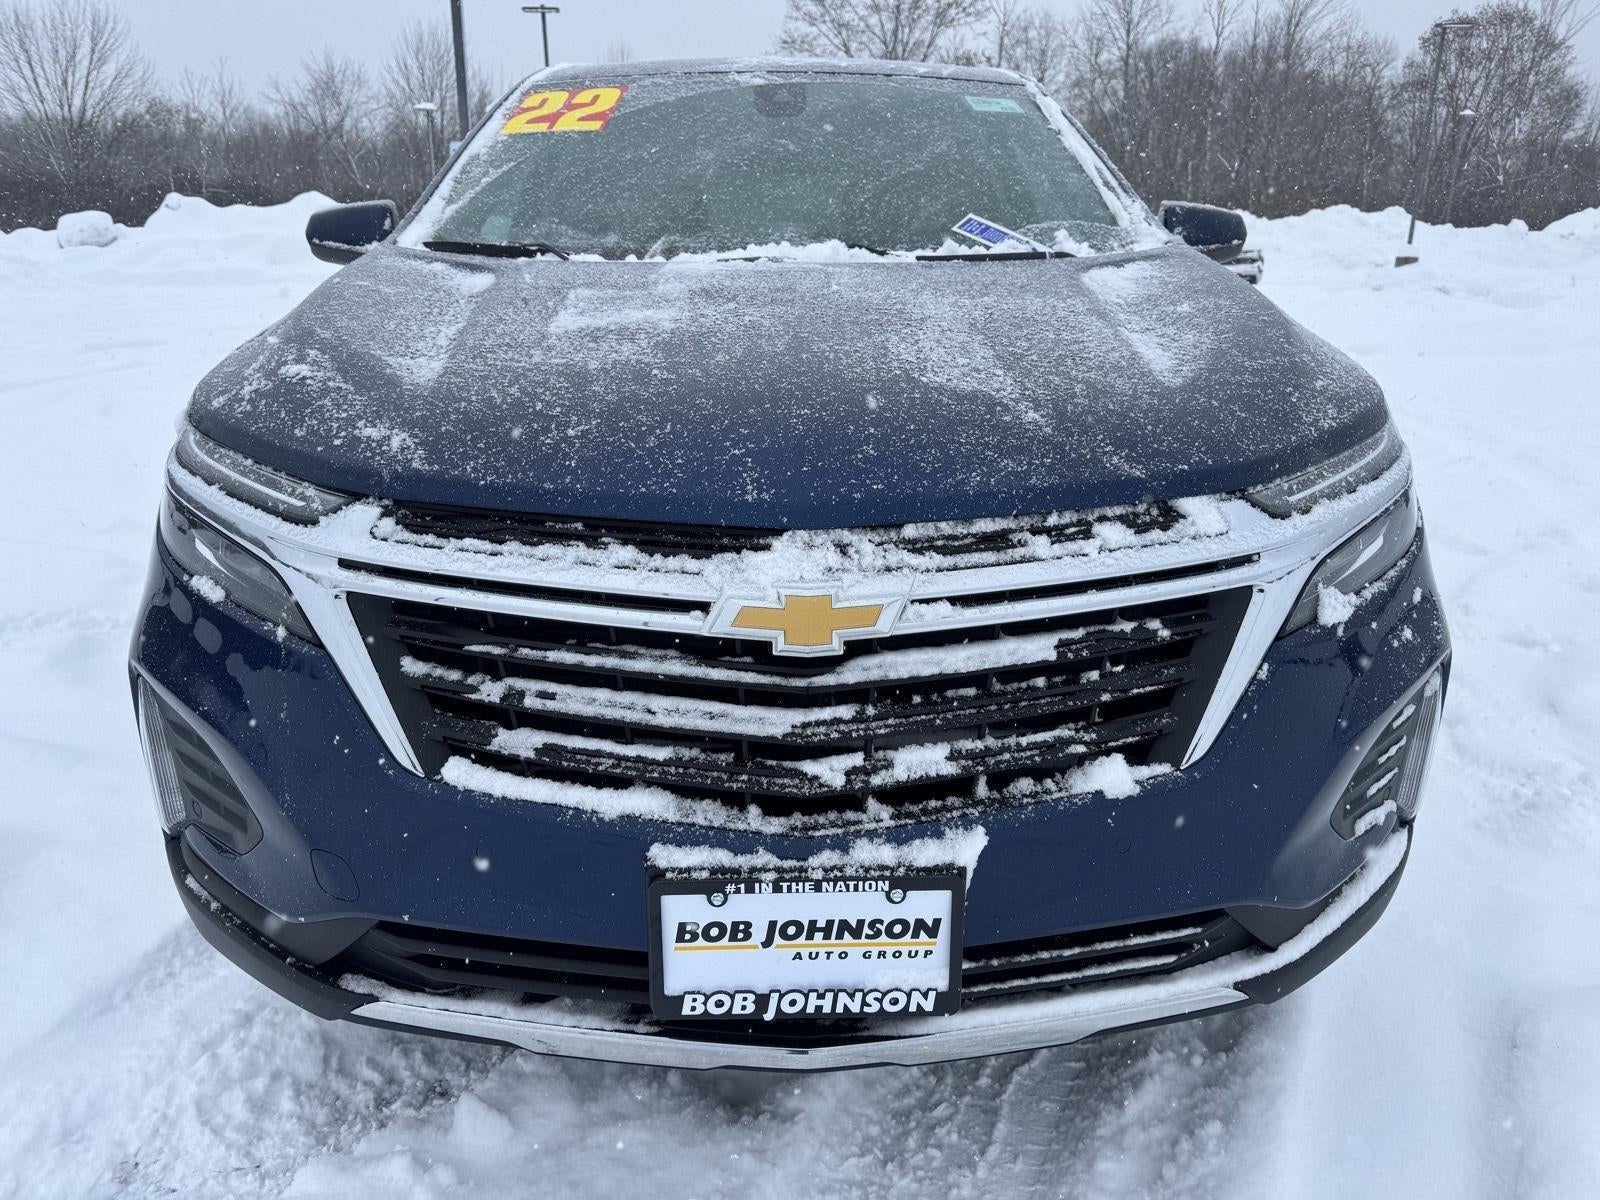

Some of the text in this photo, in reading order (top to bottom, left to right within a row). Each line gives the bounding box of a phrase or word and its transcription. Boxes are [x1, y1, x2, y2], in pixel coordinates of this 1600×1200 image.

[502, 87, 621, 134] 22
[725, 880, 890, 895] #1 IN THE NATION
[675, 917, 942, 949] BOB JOHNSON
[791, 949, 935, 961] AUTO GROUP
[681, 990, 937, 1021] BOB JOHNSON
